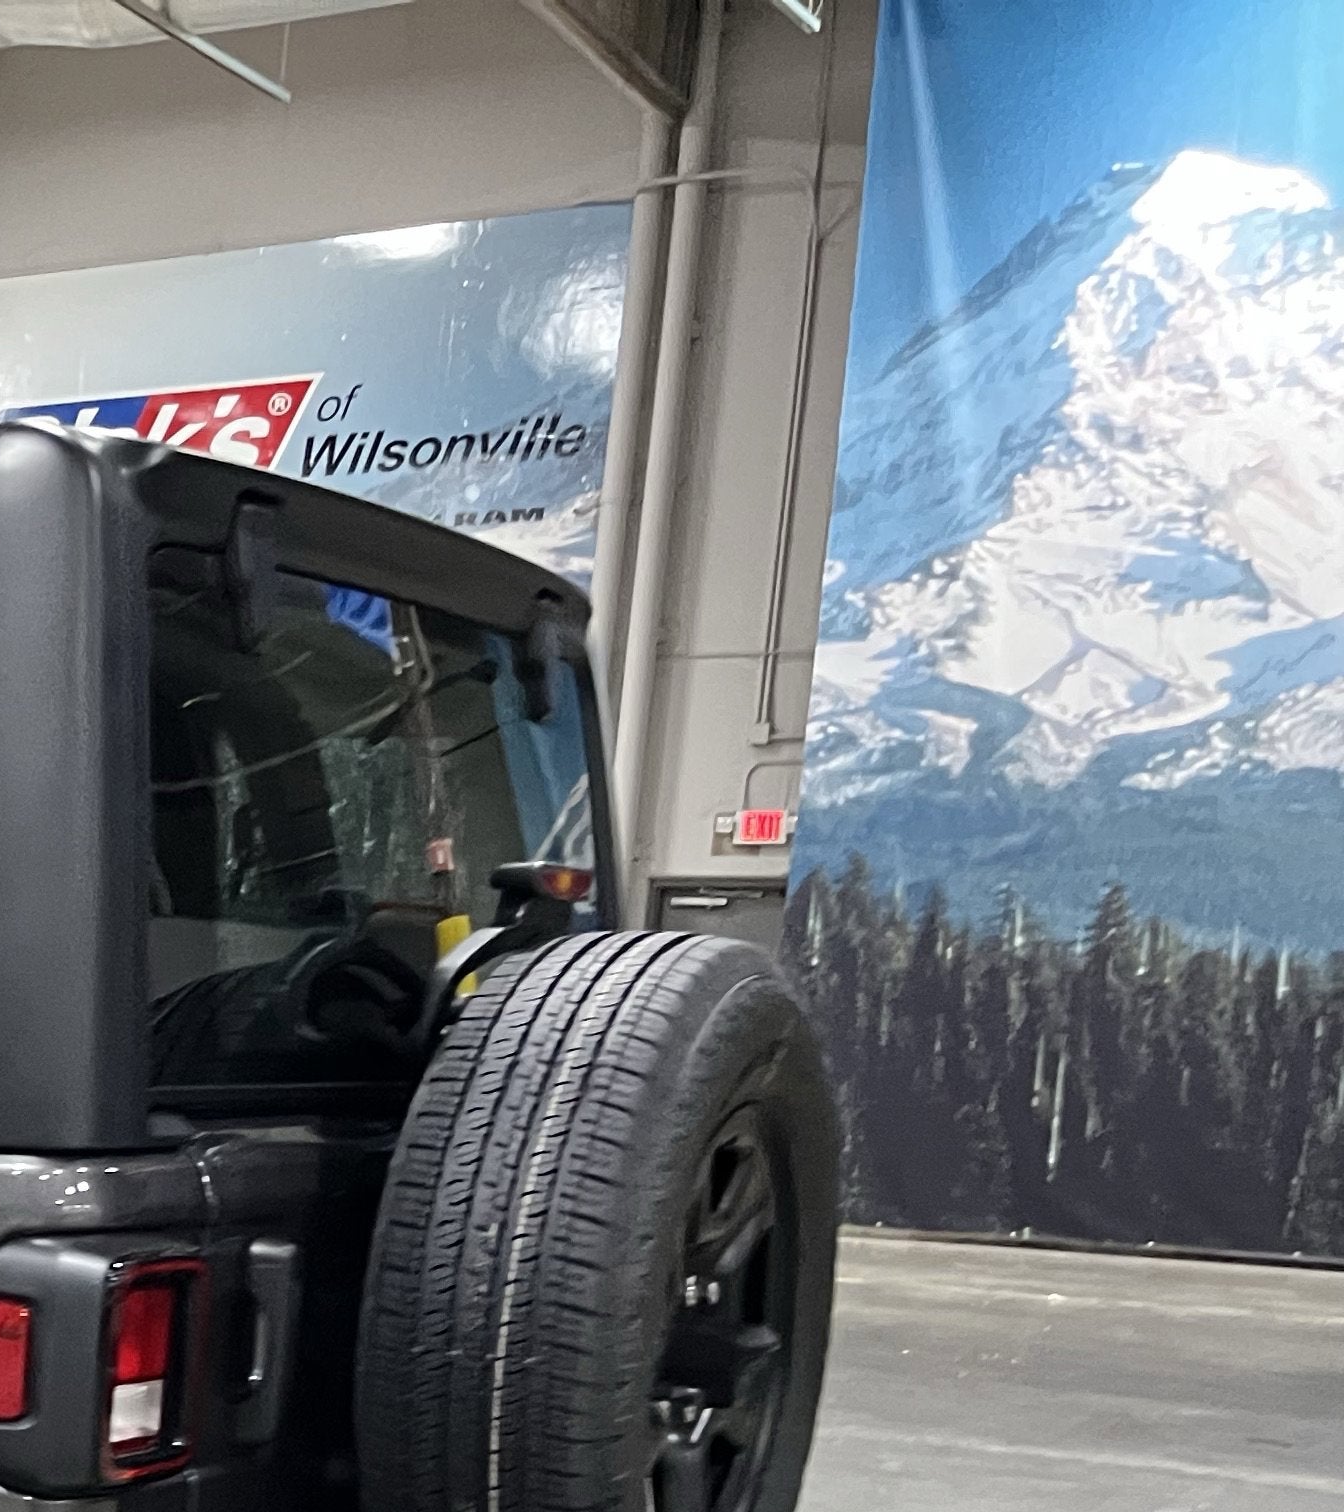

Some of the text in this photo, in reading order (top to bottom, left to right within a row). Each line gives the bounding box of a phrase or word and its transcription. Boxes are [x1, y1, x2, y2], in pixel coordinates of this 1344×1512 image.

[316, 382, 364, 423] of
[300, 411, 588, 479] Wilsonville
[745, 812, 781, 840] EXIT
